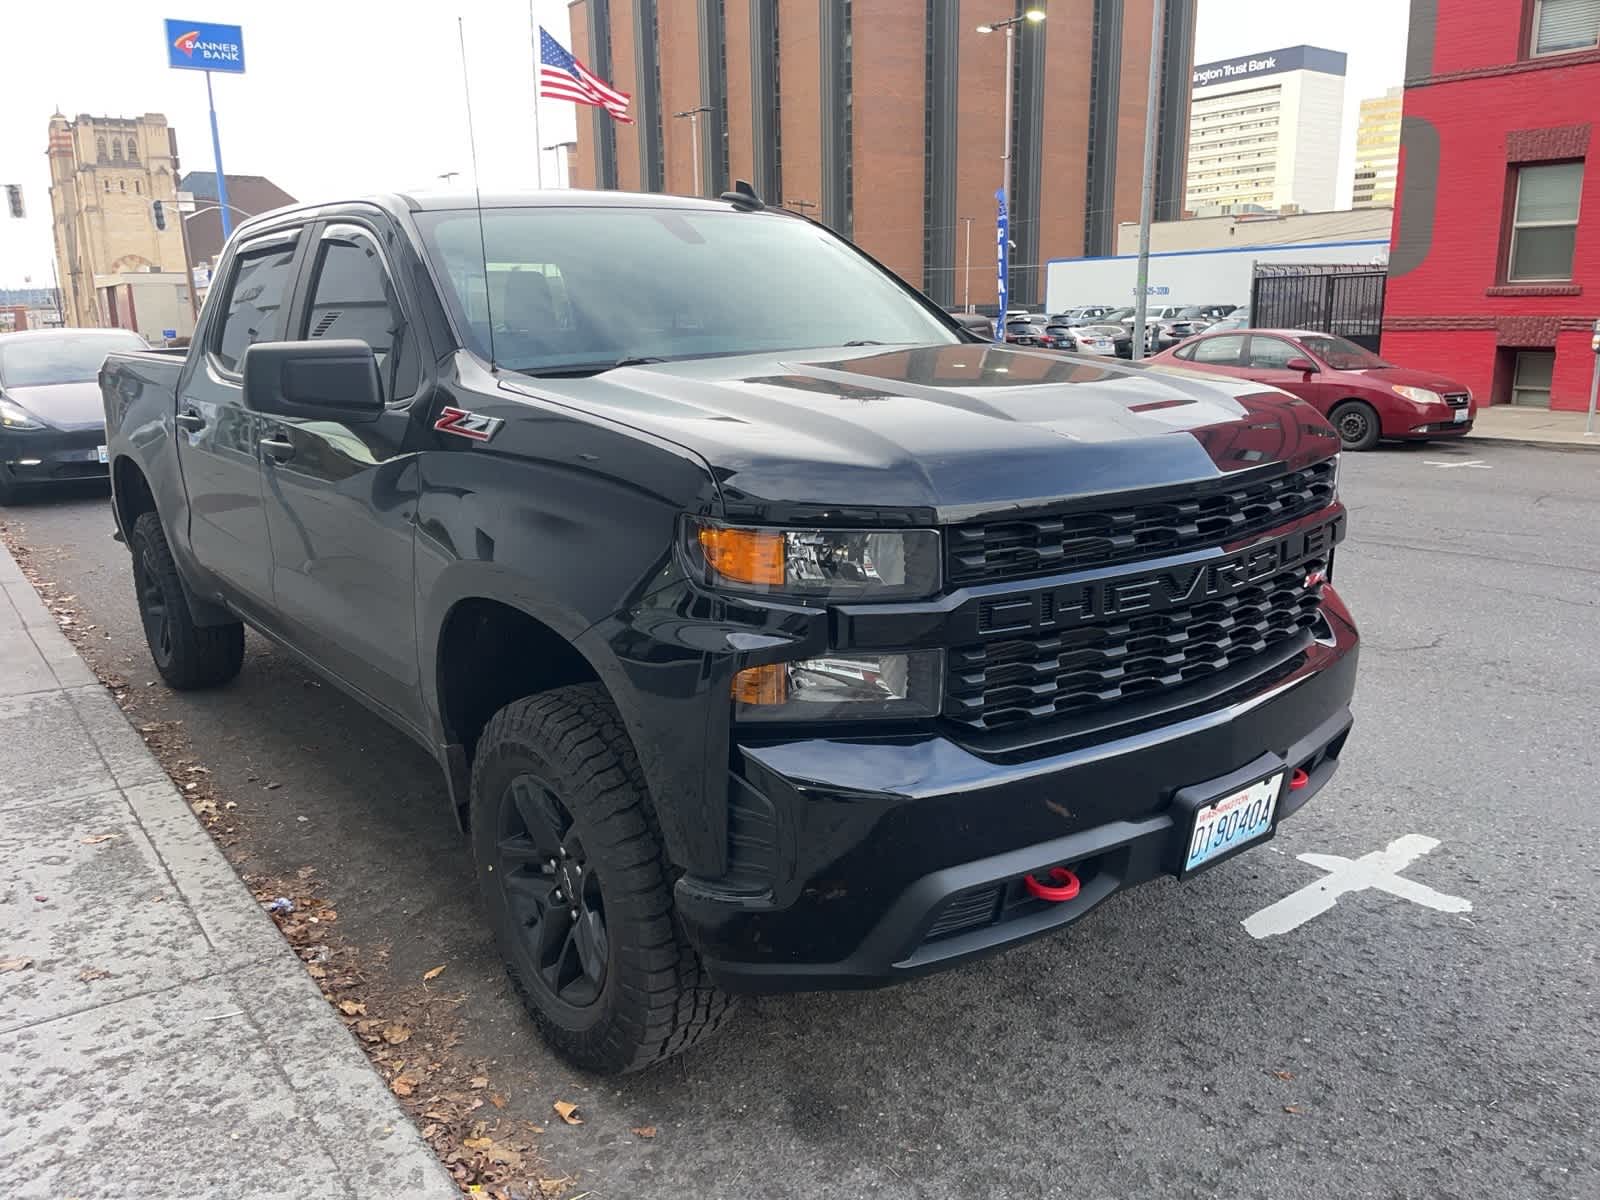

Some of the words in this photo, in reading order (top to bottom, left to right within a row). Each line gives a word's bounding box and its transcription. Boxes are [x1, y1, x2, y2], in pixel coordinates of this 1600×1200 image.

[185, 41, 239, 52] BANNER
[203, 50, 240, 61] BANK
[1222, 63, 1247, 76] Trust
[1249, 57, 1277, 72] Bank
[434, 406, 504, 442] Z71
[977, 514, 1343, 634] CHEVROLET
[1191, 794, 1272, 860] D19040A
